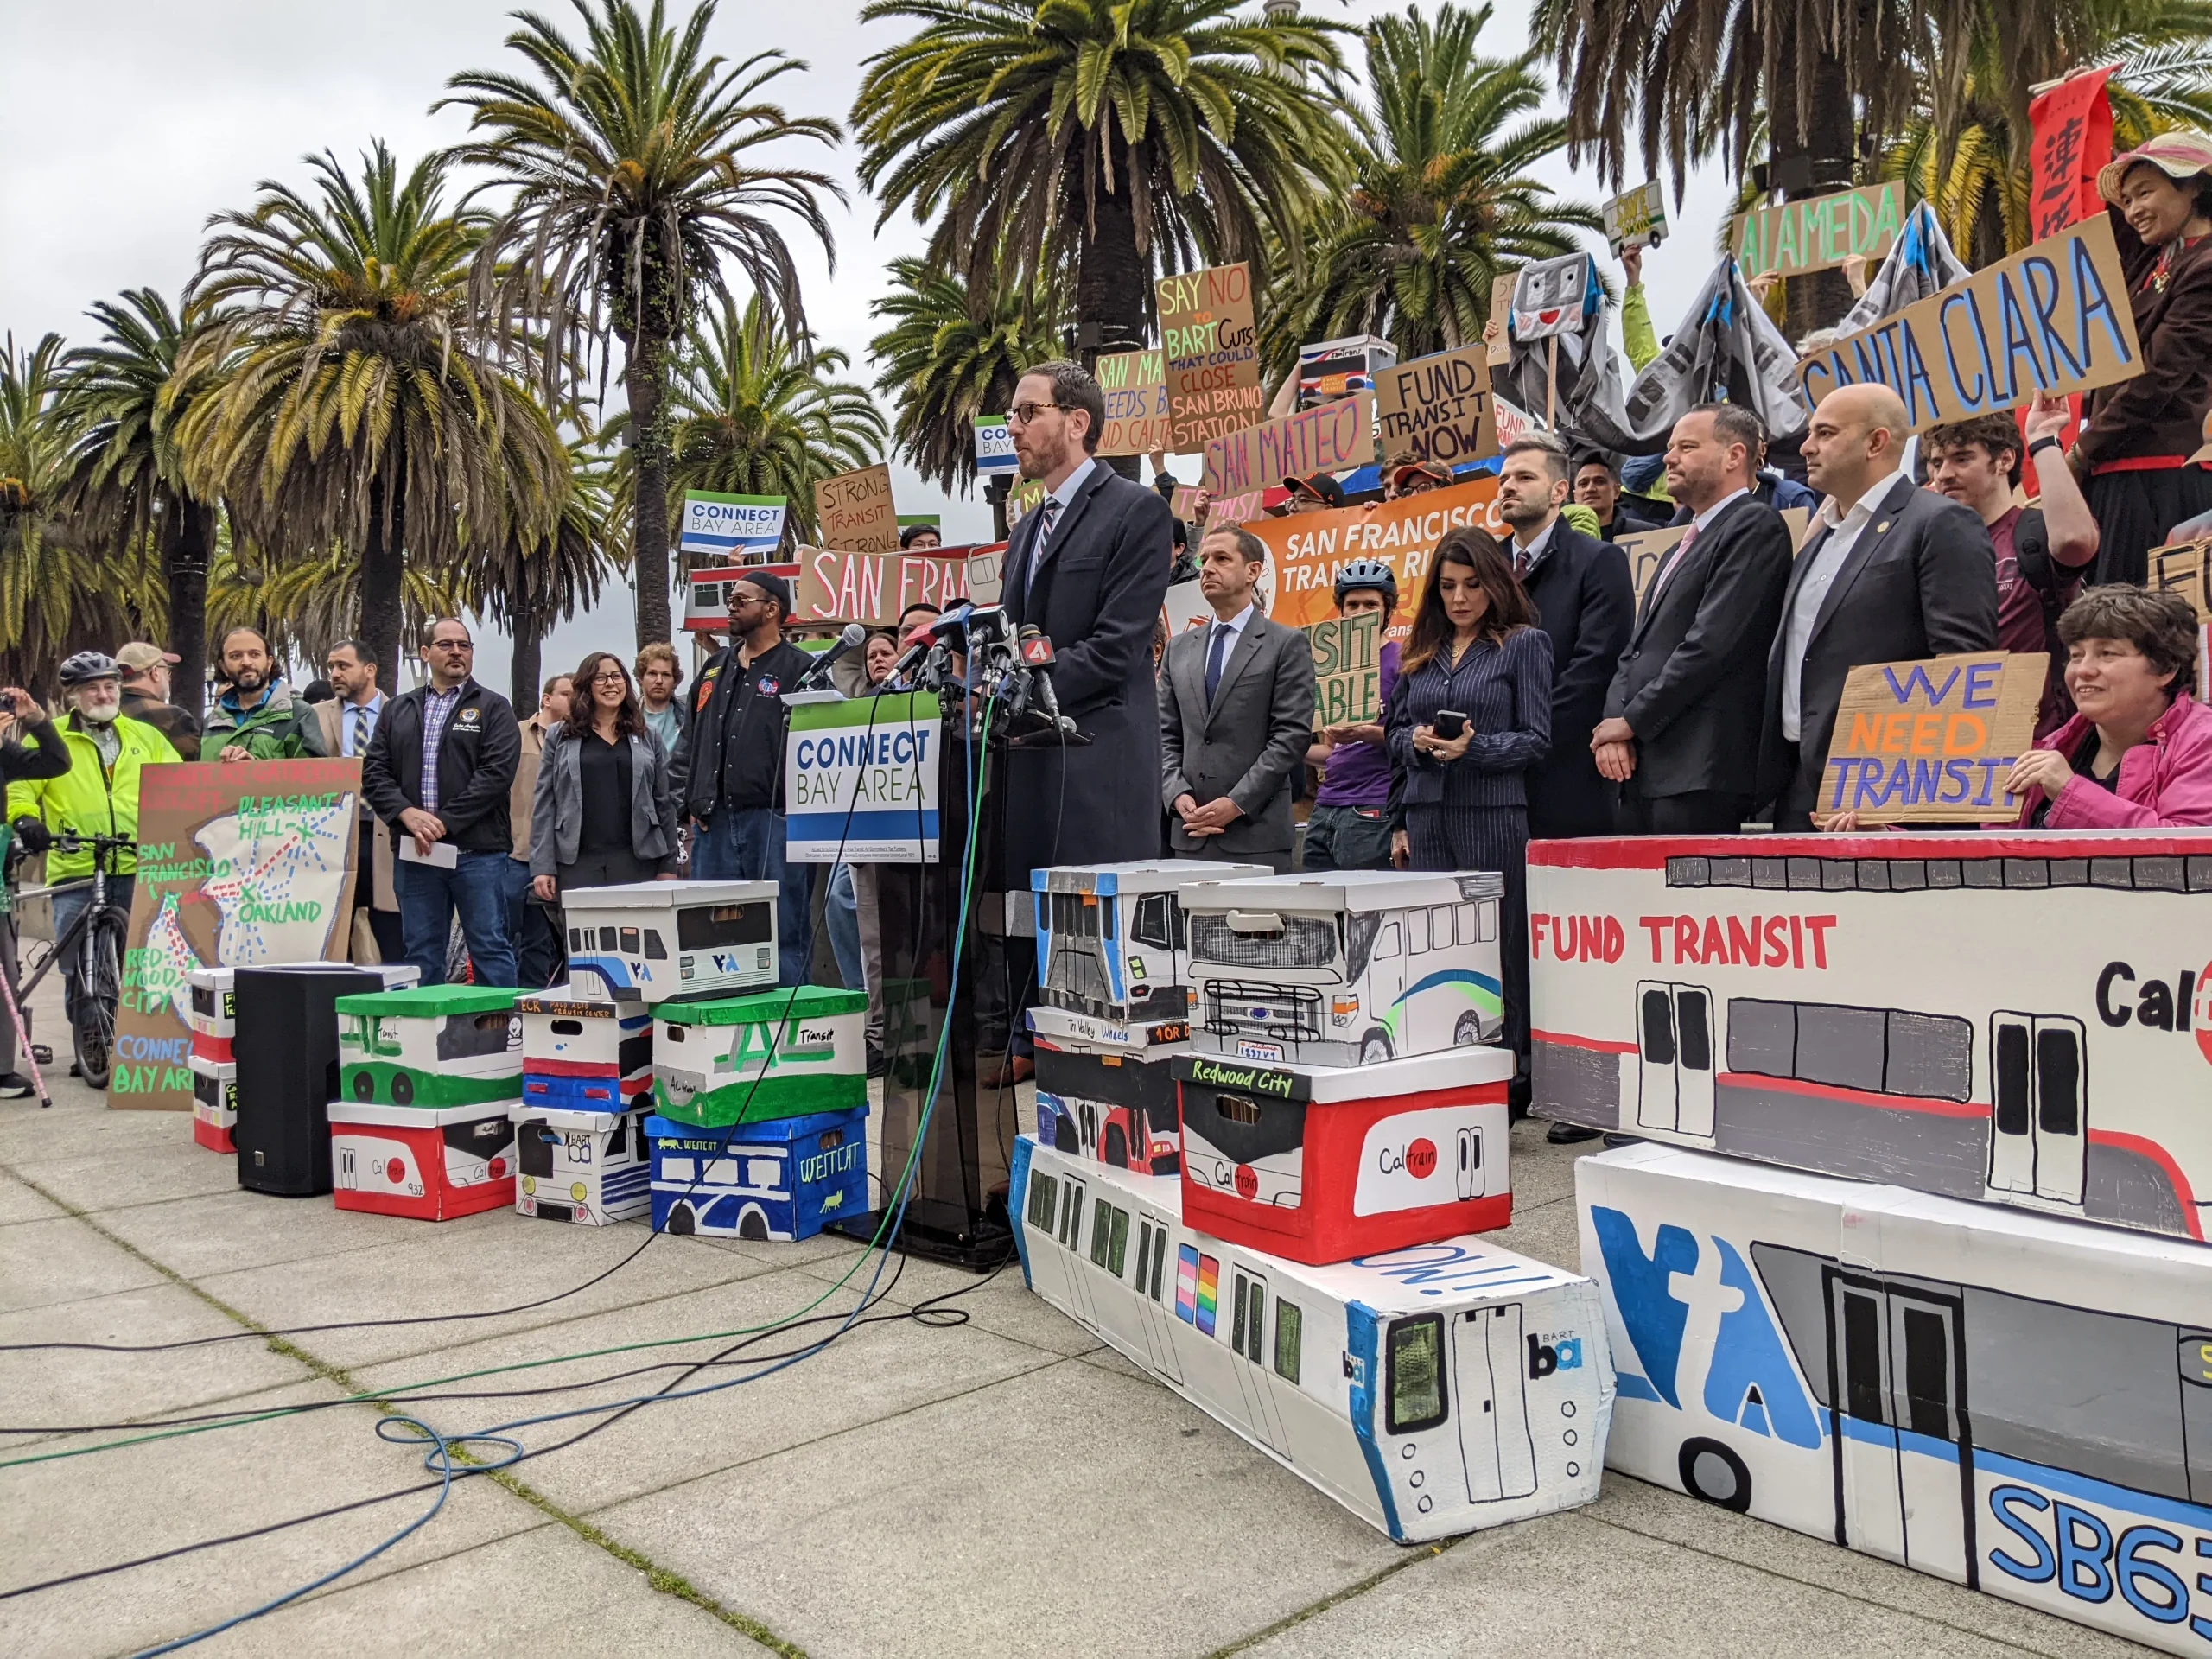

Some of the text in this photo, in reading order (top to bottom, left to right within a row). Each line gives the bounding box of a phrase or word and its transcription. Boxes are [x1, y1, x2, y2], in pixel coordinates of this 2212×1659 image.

[1739, 185, 1901, 277] ALAMEDA
[1159, 266, 1246, 315] SAY NO
[1193, 311, 1212, 324] TO
[1940, 236, 2133, 414] CLARA
[1164, 321, 1218, 359] BART
[1098, 355, 1129, 388] SAN
[1168, 346, 1253, 372] THAT COULD
[1180, 364, 1236, 393] CLOSE
[1397, 359, 1476, 409] FUND
[1103, 390, 1147, 419] EEDS
[1172, 385, 1262, 419] SAN BRUNO
[1381, 391, 1486, 438] TRANSIT
[1173, 410, 1258, 447] STATION
[1495, 404, 1526, 433] FUND
[982, 428, 1007, 441] CO
[983, 440, 1012, 454] BAY
[1207, 397, 1360, 499] SAN MATEO
[1411, 416, 1480, 462] NOW
[823, 473, 889, 510] STRONG
[1024, 487, 1044, 512] M
[692, 505, 779, 522] CONNECT
[692, 518, 775, 535] BAY AREA
[827, 504, 888, 532] TRANSIT
[827, 531, 898, 553] STRONG
[1285, 498, 1502, 561] SAN FRANCISCO
[1282, 547, 1434, 594] TRANT RI
[810, 551, 884, 620] SAN
[1029, 641, 1047, 663] 4
[1301, 612, 1379, 677] SIT
[1881, 661, 2003, 710] WE
[1847, 713, 1986, 756] NEED
[797, 729, 930, 770] CONNECT
[797, 767, 925, 805] BAY AREA
[1828, 756, 2018, 810] TRANSIT
[238, 791, 338, 821] PLEASANT
[239, 817, 283, 841] HILL
[138, 842, 175, 861] SAN
[138, 858, 231, 884] FRANCISCO
[239, 902, 321, 924] OAKLAND
[1530, 913, 1837, 970] FUND TRANSIT
[122, 991, 173, 1015] CITY
[521, 999, 542, 1013] ECR
[585, 1009, 610, 1018] CENTER
[800, 1028, 835, 1043] Transit
[1068, 1019, 1128, 1042] Tri Valley Wheels
[113, 1064, 158, 1094] BAY
[670, 1076, 681, 1091] AC
[1192, 1060, 1293, 1099] Redwood City
[571, 1134, 592, 1145] BART
[799, 1141, 861, 1183] WESTCAT
[408, 1182, 424, 1196] 932
[1542, 1330, 1575, 1343] BART
